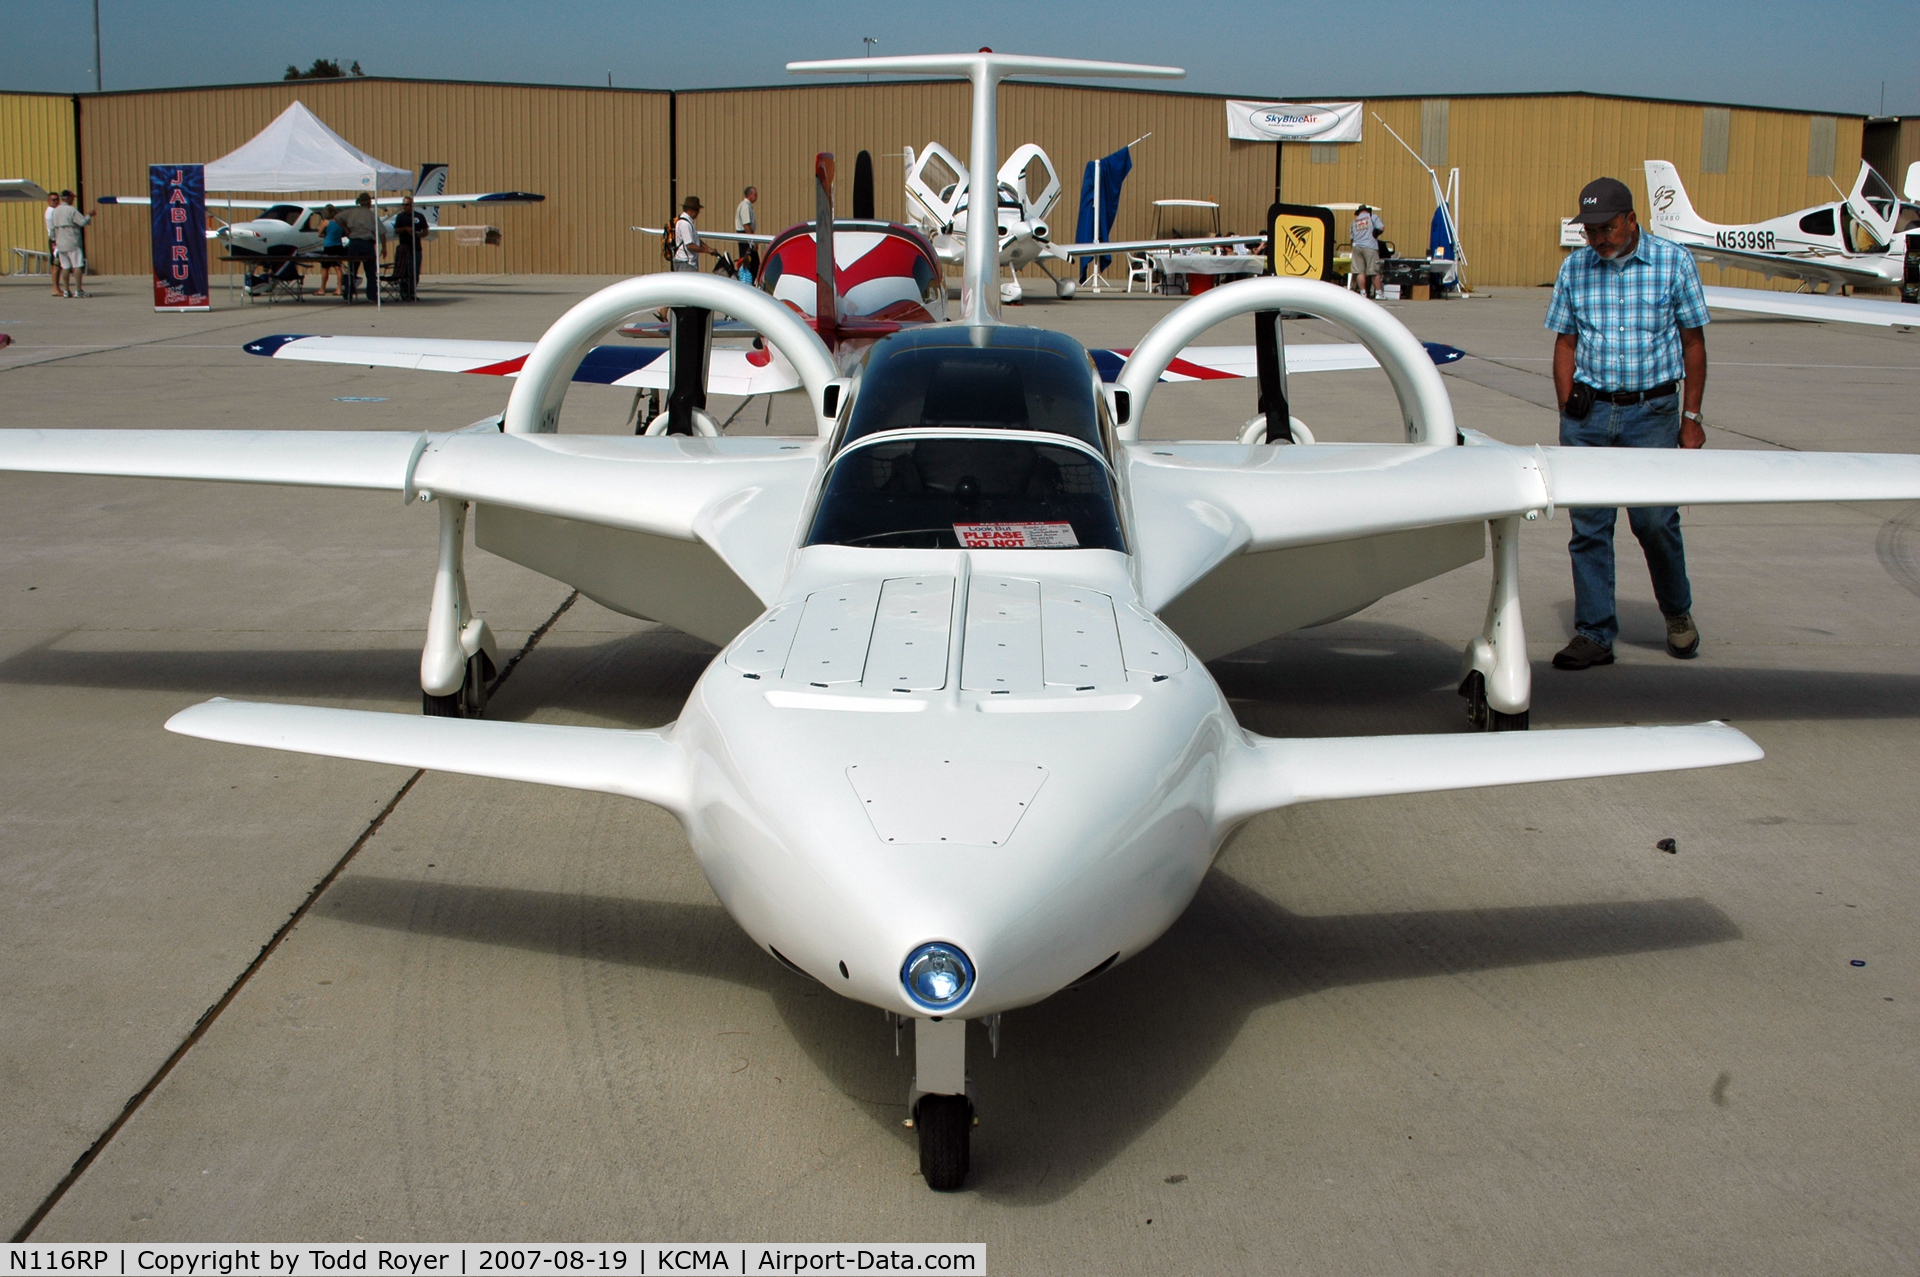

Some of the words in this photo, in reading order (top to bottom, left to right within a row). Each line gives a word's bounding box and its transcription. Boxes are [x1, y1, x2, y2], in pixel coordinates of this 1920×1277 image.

[432, 172, 446, 222] JAIRU
[170, 170, 188, 280] JABIRU
[1716, 231, 1775, 250] N539SR
[963, 531, 1025, 540] PLEASE
[966, 539, 989, 547] DO
[992, 539, 1026, 547] NOT
